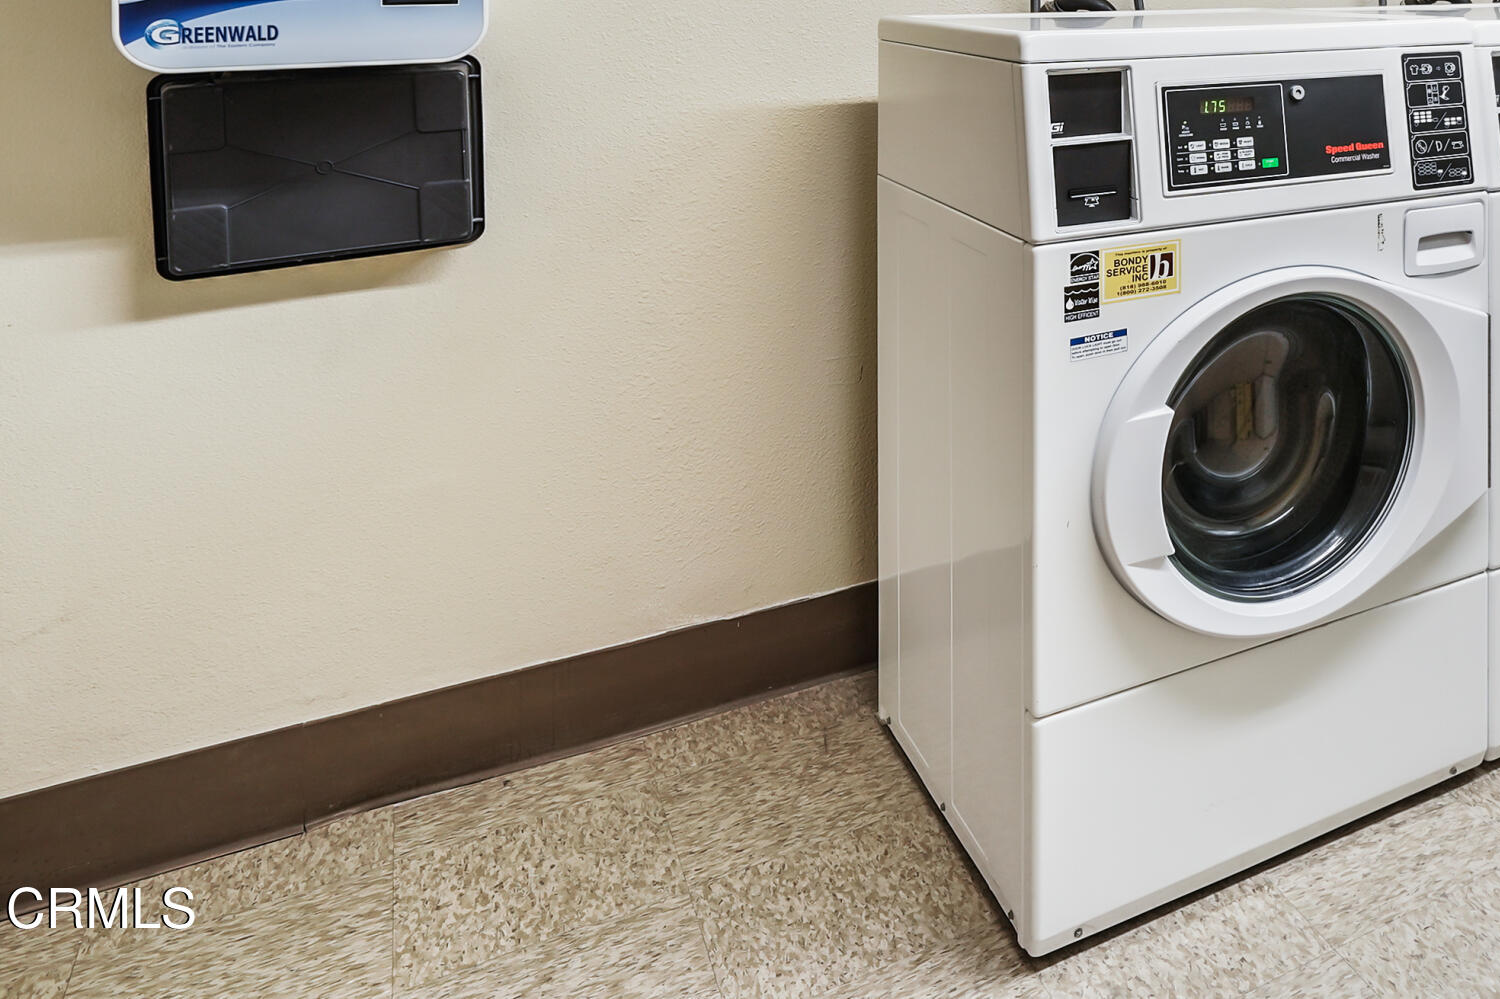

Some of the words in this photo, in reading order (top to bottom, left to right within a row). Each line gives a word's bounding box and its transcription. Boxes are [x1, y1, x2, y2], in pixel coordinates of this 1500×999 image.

[150, 23, 279, 46] GREENWALD
[1325, 143, 1354, 155] Speed
[1355, 142, 1384, 151] Queen
[1331, 154, 1361, 163] Commercial
[1114, 255, 1148, 267] BONDY
[1106, 264, 1148, 278] SERVICE
[1132, 273, 1148, 282] INC
[1084, 332, 1114, 343] NOTICE
